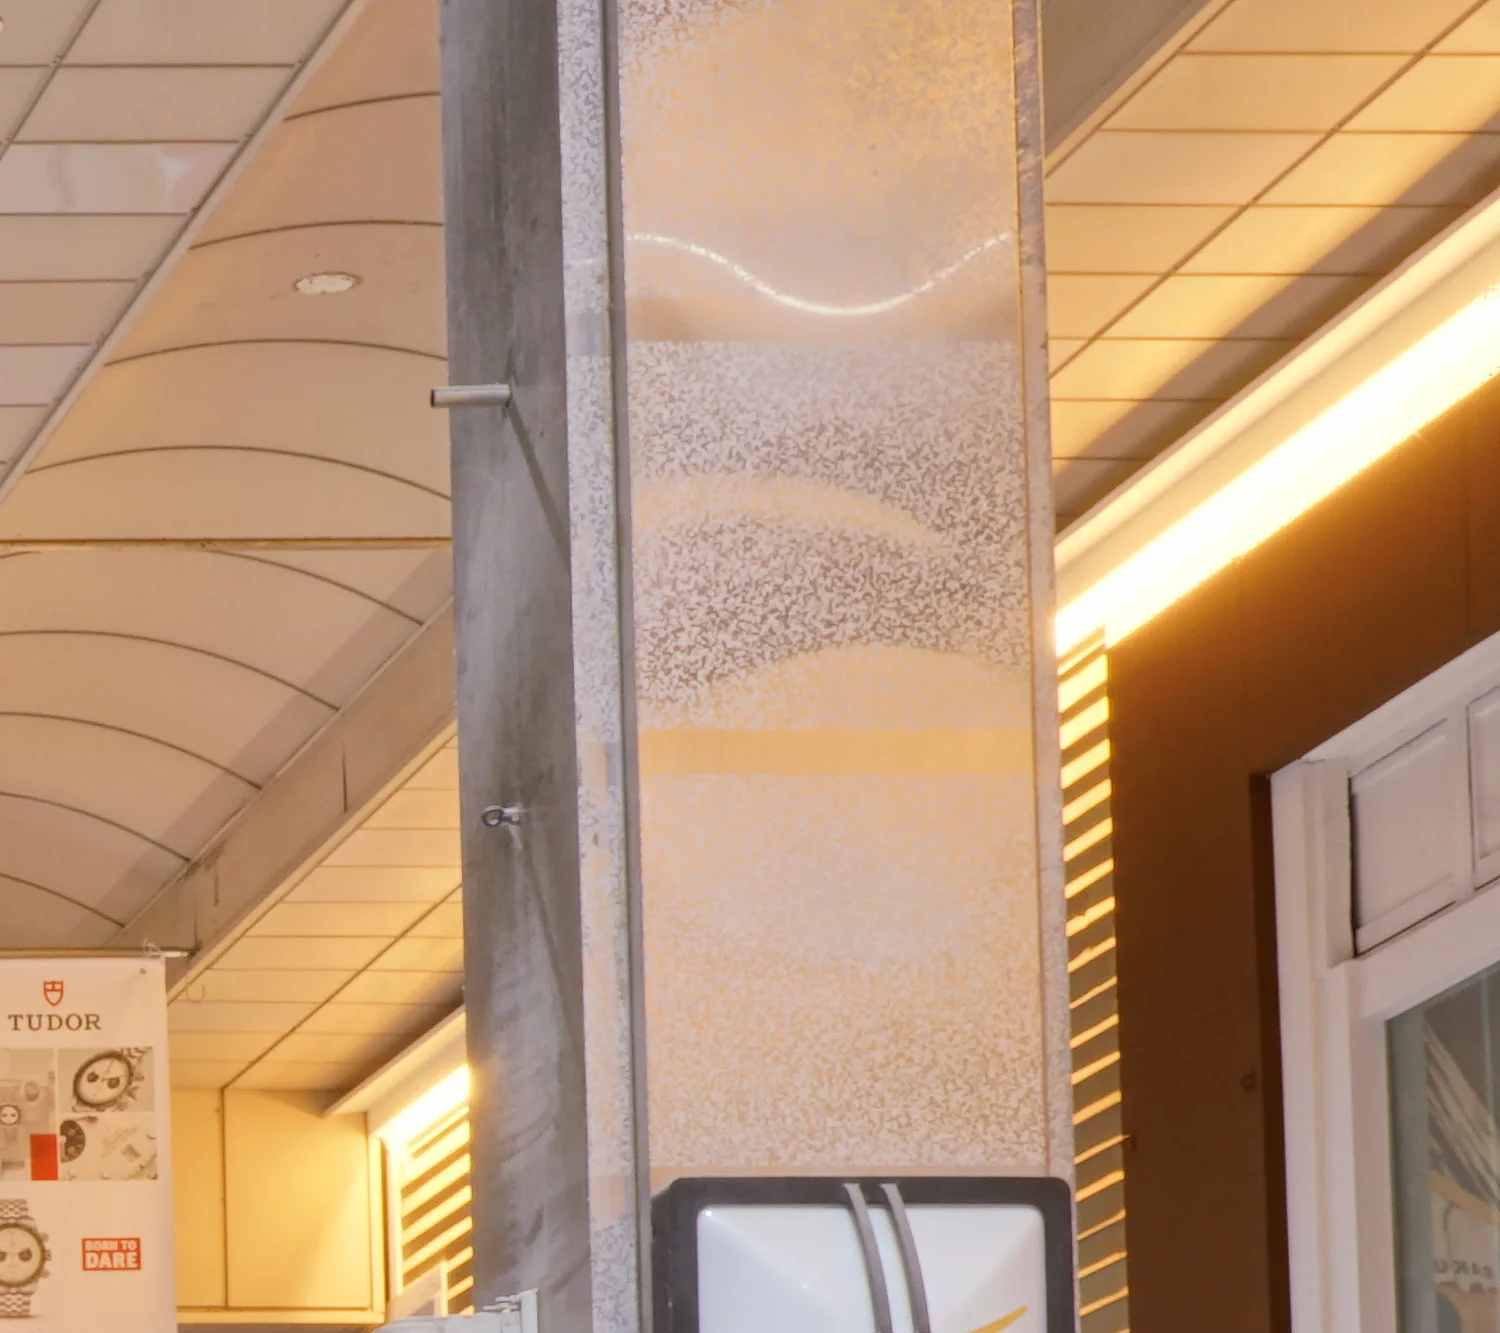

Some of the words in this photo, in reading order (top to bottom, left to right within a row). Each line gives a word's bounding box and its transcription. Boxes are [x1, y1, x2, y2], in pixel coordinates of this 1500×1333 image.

[7, 1013, 102, 1031] TUDOR
[122, 1240, 138, 1250] TO
[85, 1251, 139, 1269] DARE
